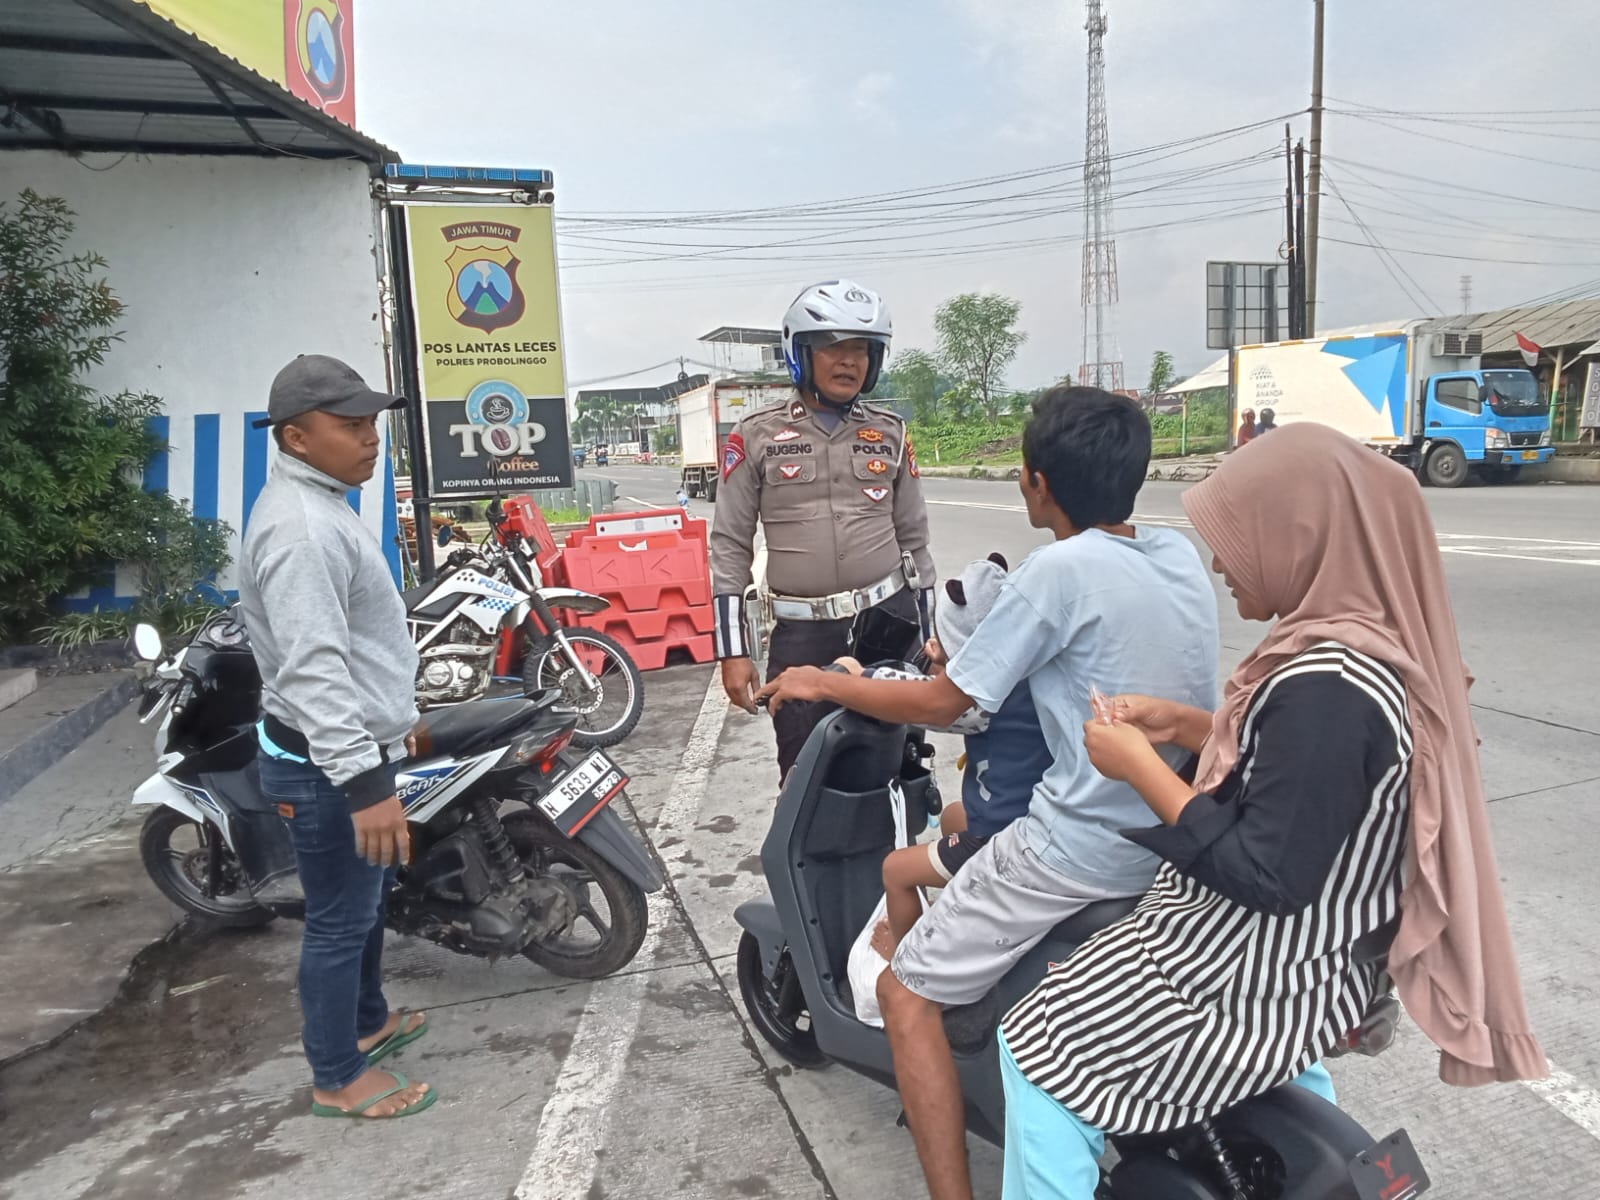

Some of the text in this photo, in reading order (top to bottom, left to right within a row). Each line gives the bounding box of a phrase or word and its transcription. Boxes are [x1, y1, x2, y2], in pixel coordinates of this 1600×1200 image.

[451, 225, 512, 237] JAWA TIMUR
[424, 342, 557, 354] POS LANTAS LECES
[436, 357, 547, 366] POLRES PROBOLINGGO
[449, 422, 546, 457] TOP
[766, 444, 812, 457] SUGENG
[852, 444, 893, 457] POLRI
[442, 479, 480, 488] KOPINYA
[514, 476, 560, 485] INDONESIA
[478, 577, 517, 598] POLISI
[543, 801, 560, 817] N
[560, 772, 592, 801] 5639
